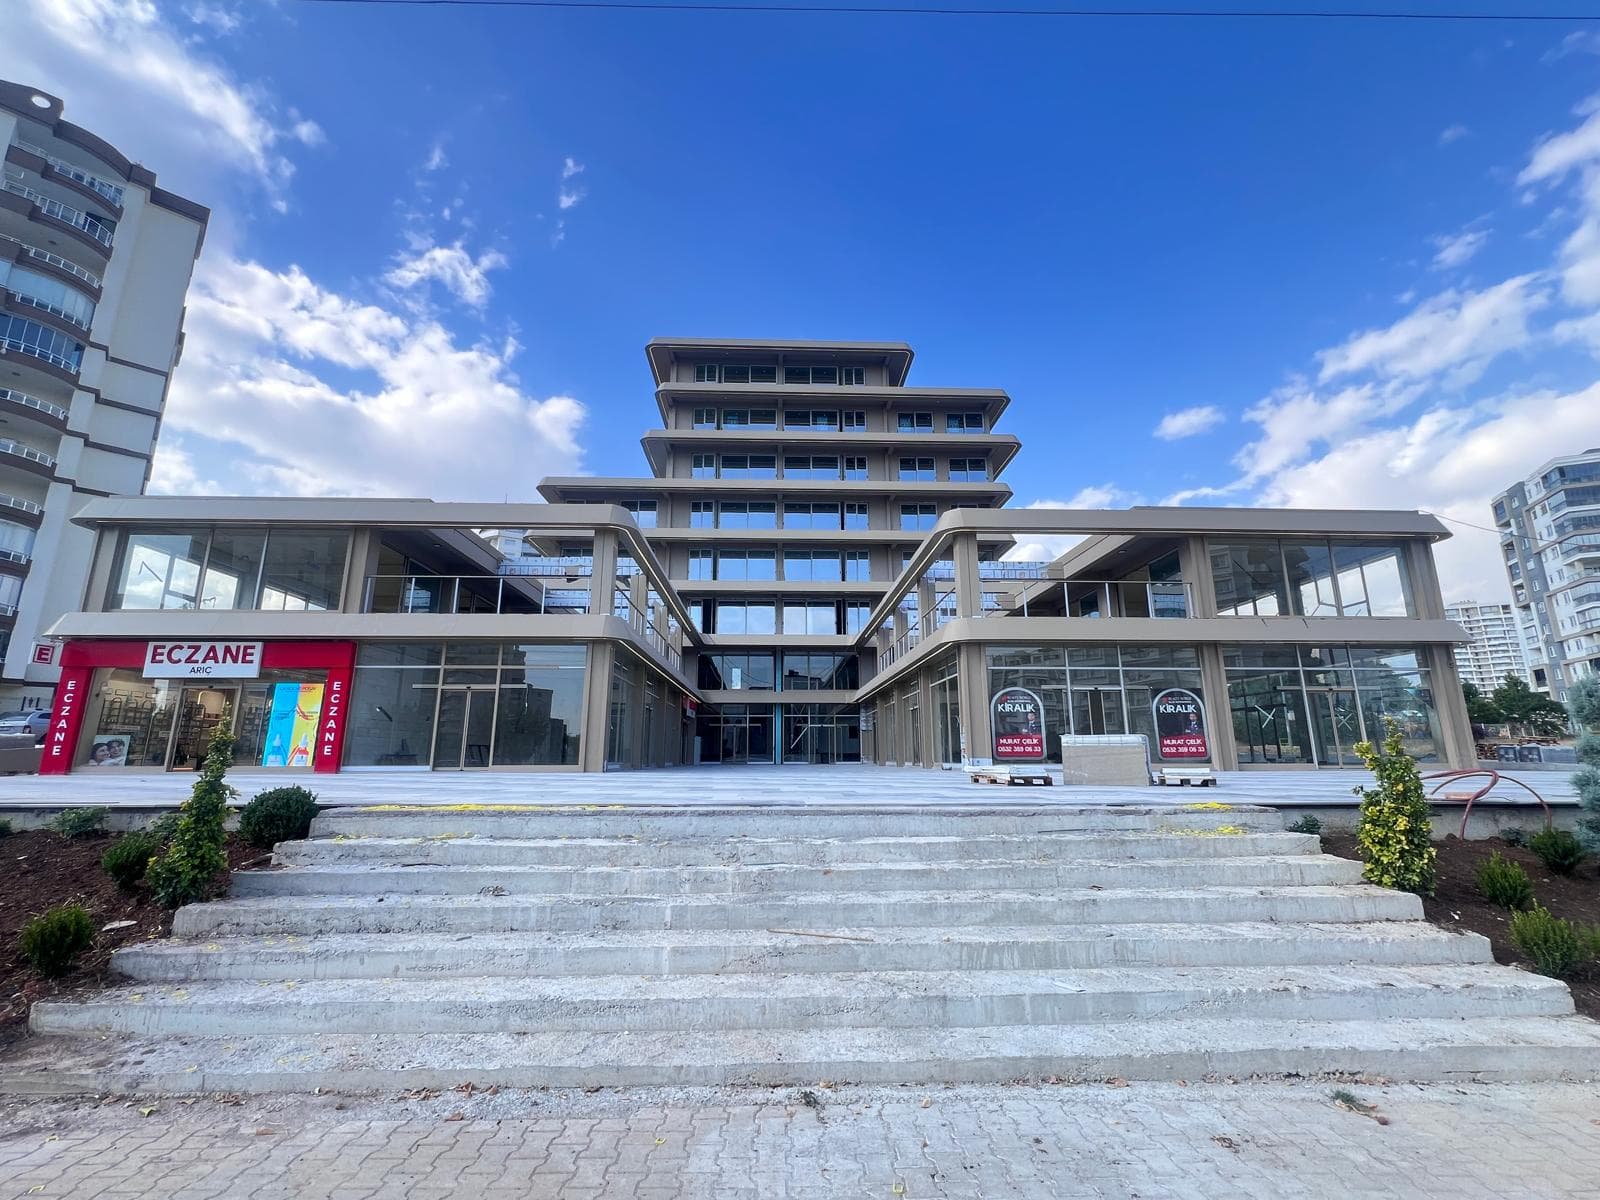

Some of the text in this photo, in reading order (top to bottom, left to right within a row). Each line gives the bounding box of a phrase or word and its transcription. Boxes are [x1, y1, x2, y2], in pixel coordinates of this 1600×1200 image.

[150, 645, 256, 664] ECZANE
[997, 702, 1035, 712] KİRALIK
[1159, 704, 1197, 713] KİRALIK
[52, 680, 76, 756] ECZANE
[323, 681, 342, 756] ECZANE
